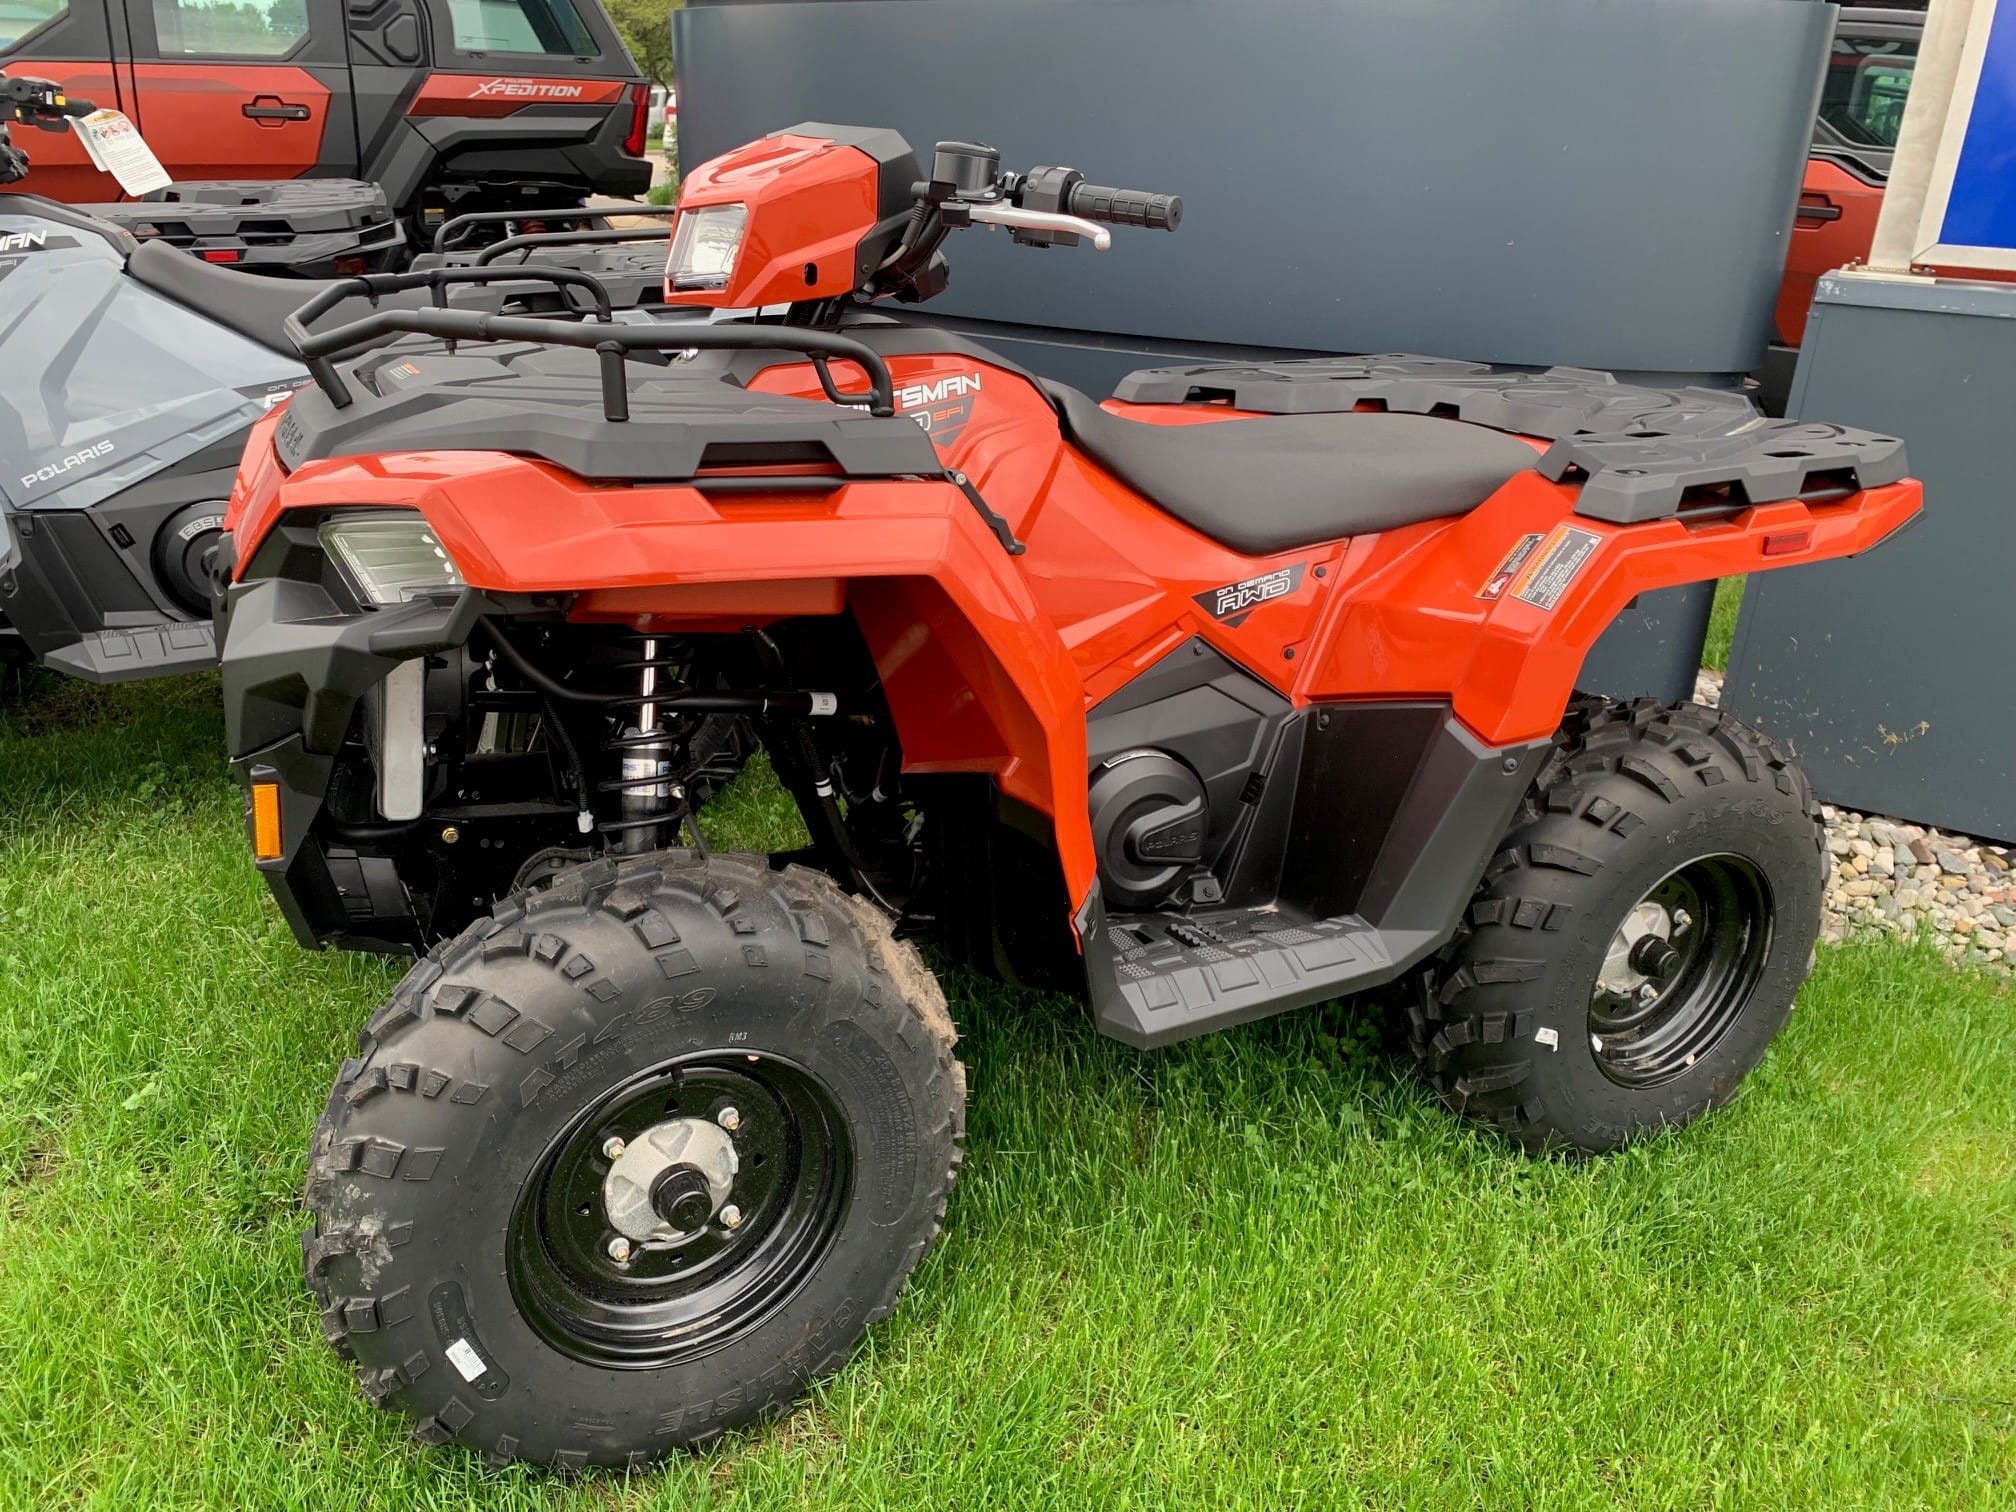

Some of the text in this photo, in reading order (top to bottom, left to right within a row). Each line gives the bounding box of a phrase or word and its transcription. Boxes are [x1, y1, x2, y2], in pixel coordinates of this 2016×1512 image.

[468, 78, 582, 98] XPEDITION
[932, 405, 964, 421] EFI
[21, 440, 114, 488] POLARIS
[1217, 577, 1290, 615] AWD
